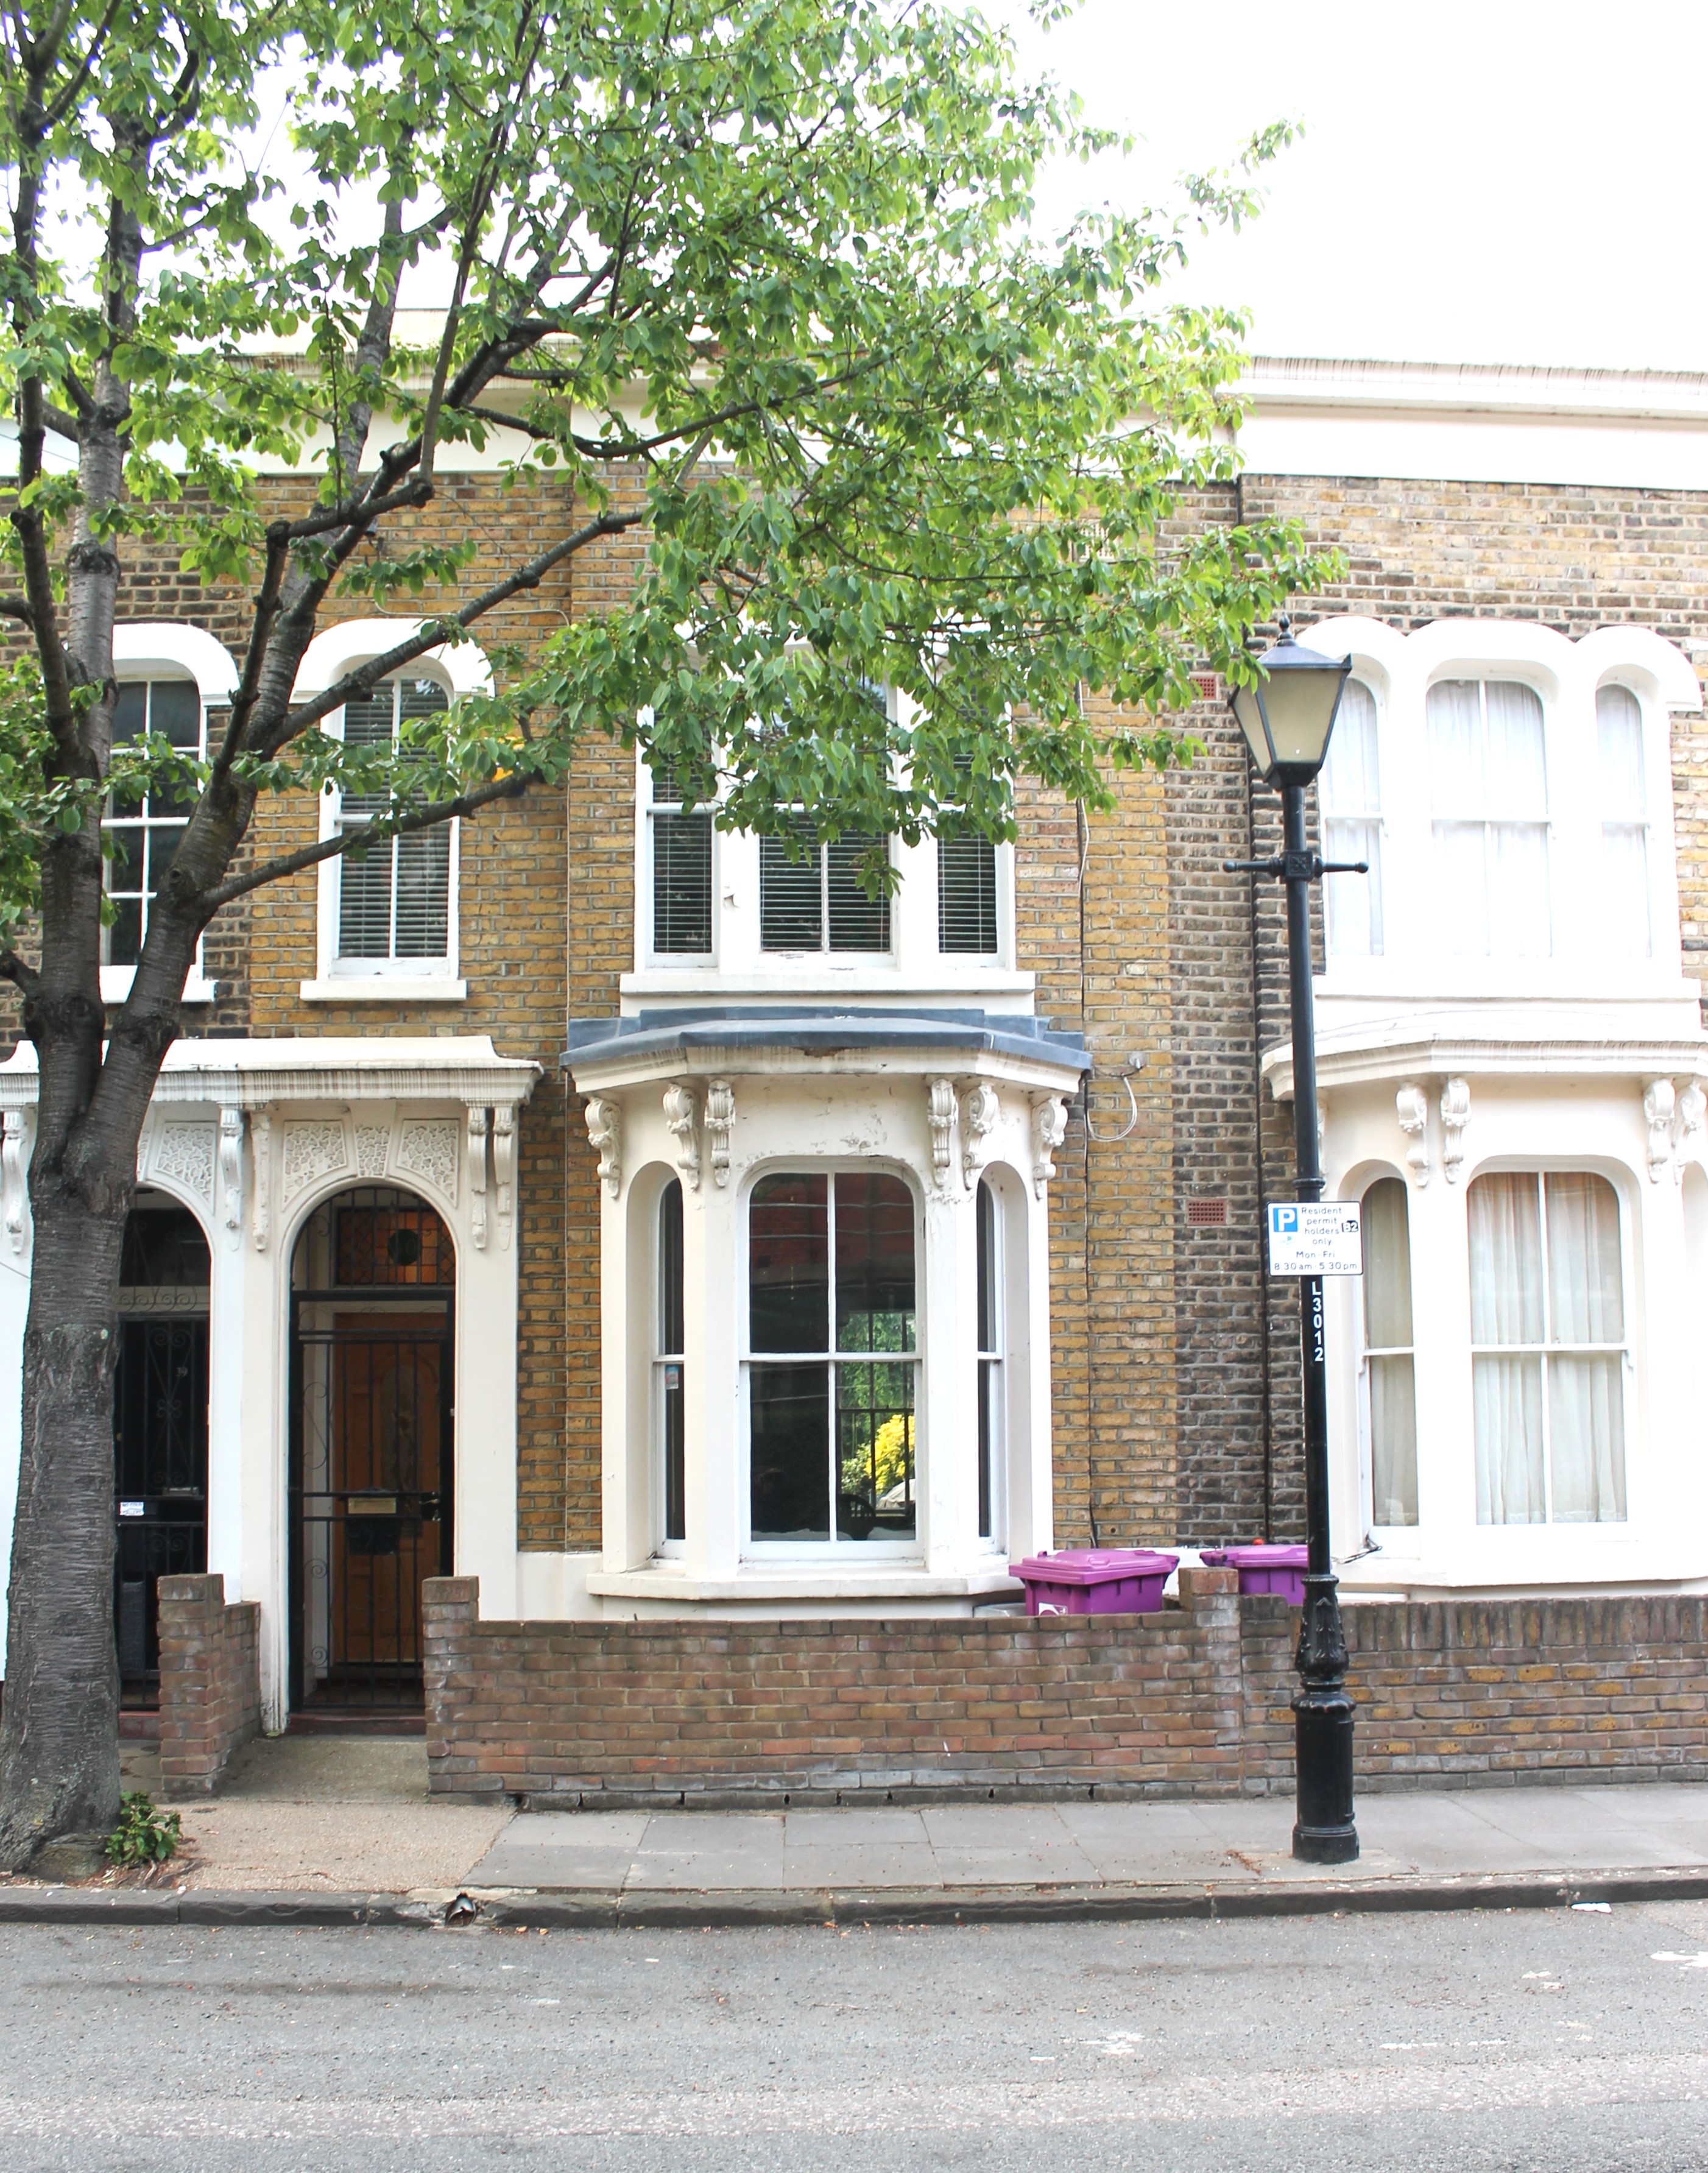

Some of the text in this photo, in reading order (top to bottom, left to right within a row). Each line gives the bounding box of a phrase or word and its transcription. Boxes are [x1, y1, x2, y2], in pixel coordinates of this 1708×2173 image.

[1278, 1209, 1295, 1232] P
[1343, 1221, 1358, 1232] B2
[1312, 1237, 1332, 1246] only
[1311, 1281, 1324, 1362] L3012
